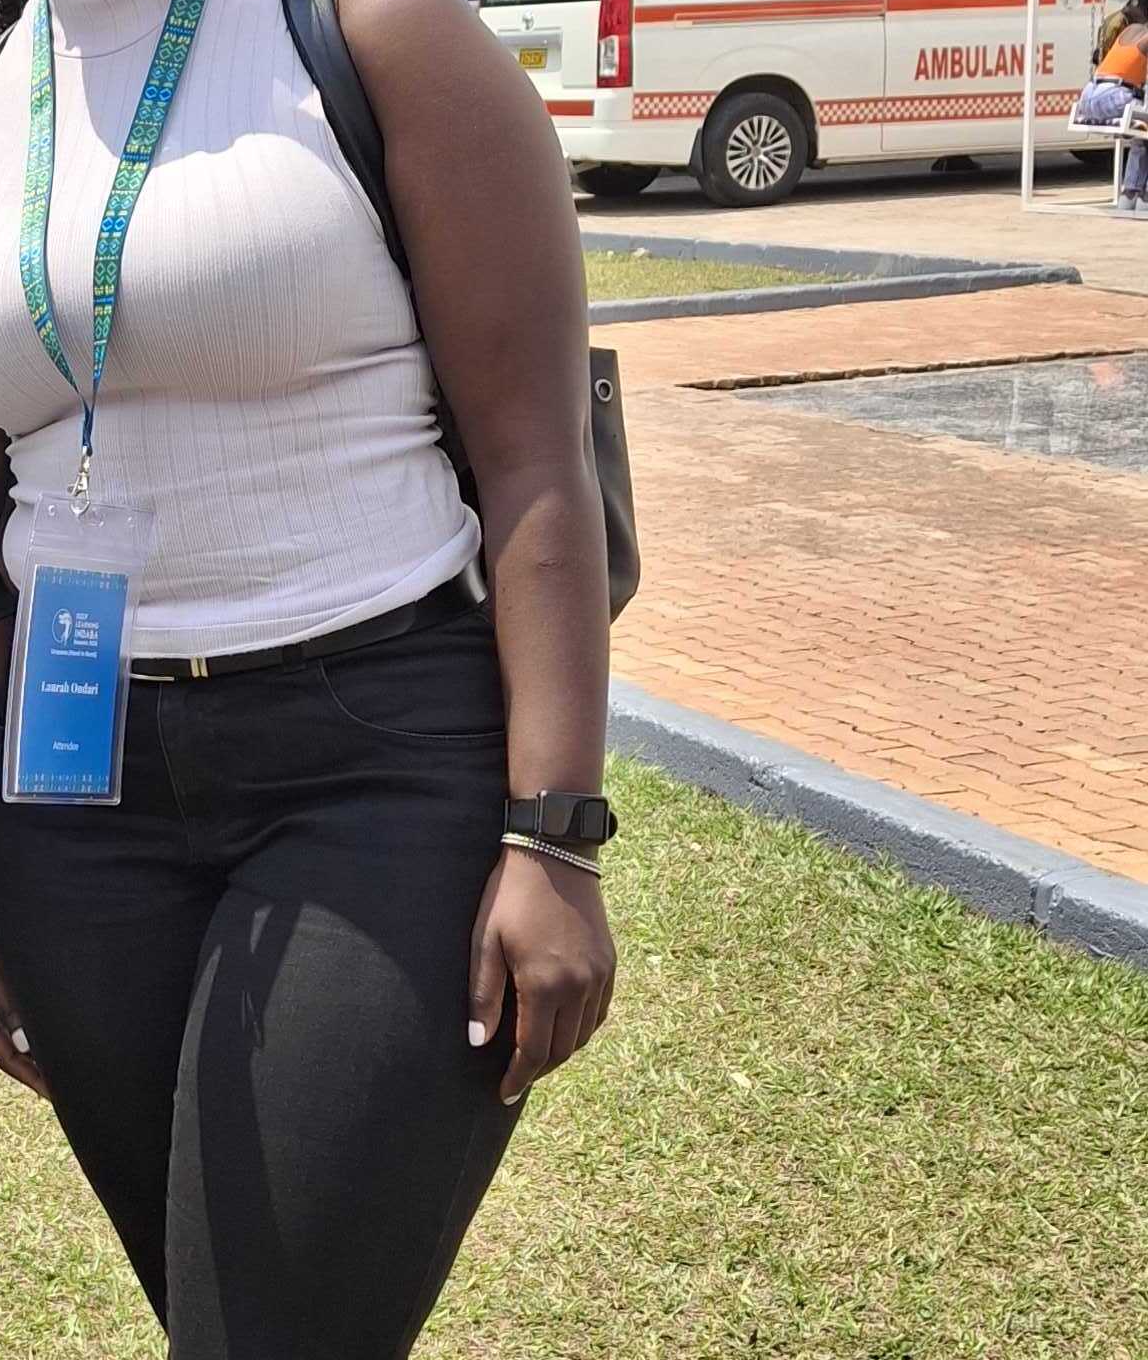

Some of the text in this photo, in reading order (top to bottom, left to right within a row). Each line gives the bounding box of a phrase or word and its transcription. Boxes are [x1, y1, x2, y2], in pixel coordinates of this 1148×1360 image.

[914, 42, 1054, 81] AMBULANE
[41, 680, 99, 695] Laurah Ondari
